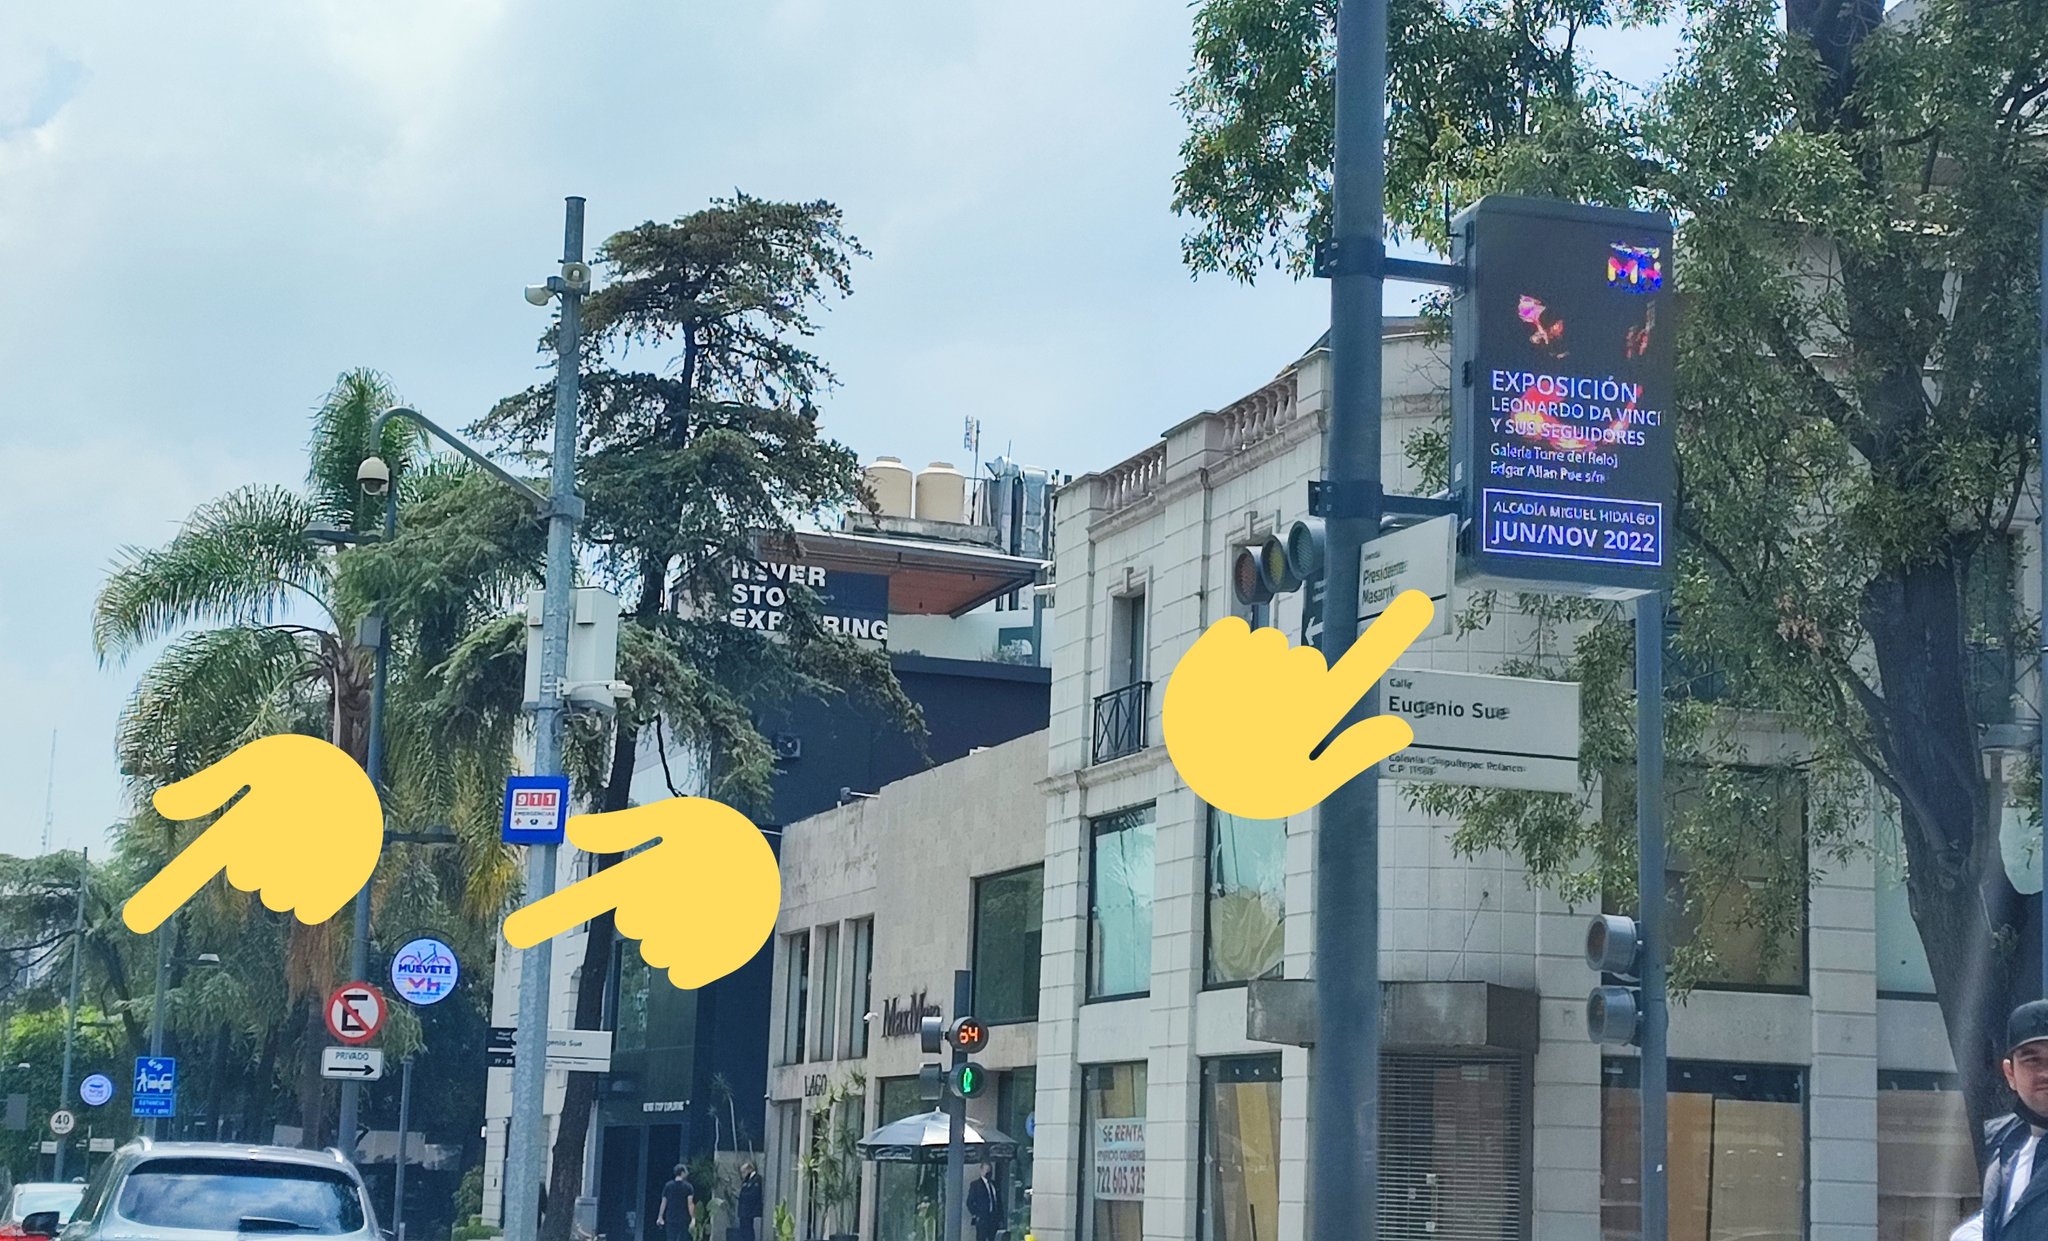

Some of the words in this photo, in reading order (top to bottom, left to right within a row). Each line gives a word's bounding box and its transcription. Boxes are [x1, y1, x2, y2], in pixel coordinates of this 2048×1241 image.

[1492, 370, 1638, 403] EXPOSICIÓN
[1491, 397, 1584, 419] LEONARDO
[1589, 405, 1612, 422] DA
[1490, 418, 1502, 433] Y
[1505, 419, 1538, 436] SUS
[1541, 423, 1646, 446] SEGUIDORES
[1567, 450, 1586, 464] del
[1490, 461, 1525, 479] Edgar
[1527, 464, 1558, 480] Allan
[1550, 506, 1597, 521] MIGUEL
[1600, 509, 1656, 526] HIDALGO
[1491, 520, 1598, 548] JUN/NOV
[1603, 530, 1655, 553] 2022
[731, 561, 826, 587] NEVER
[731, 584, 794, 607] STO
[730, 608, 888, 640] EXPRING
[1389, 678, 1413, 690] Calle
[1389, 696, 1465, 719] Eugenio
[1472, 702, 1511, 720] Sue
[518, 794, 554, 806] 911
[398, 963, 452, 975] MUEVETE
[336, 1052, 369, 1061] PRIVADO
[804, 1074, 828, 1097] LAGO
[55, 1114, 70, 1126] 40
[1103, 1125, 1113, 1142] SE
[1115, 1124, 1145, 1142] RENTA
[1097, 1166, 1111, 1193] 722
[1113, 1166, 1128, 1193] 605
